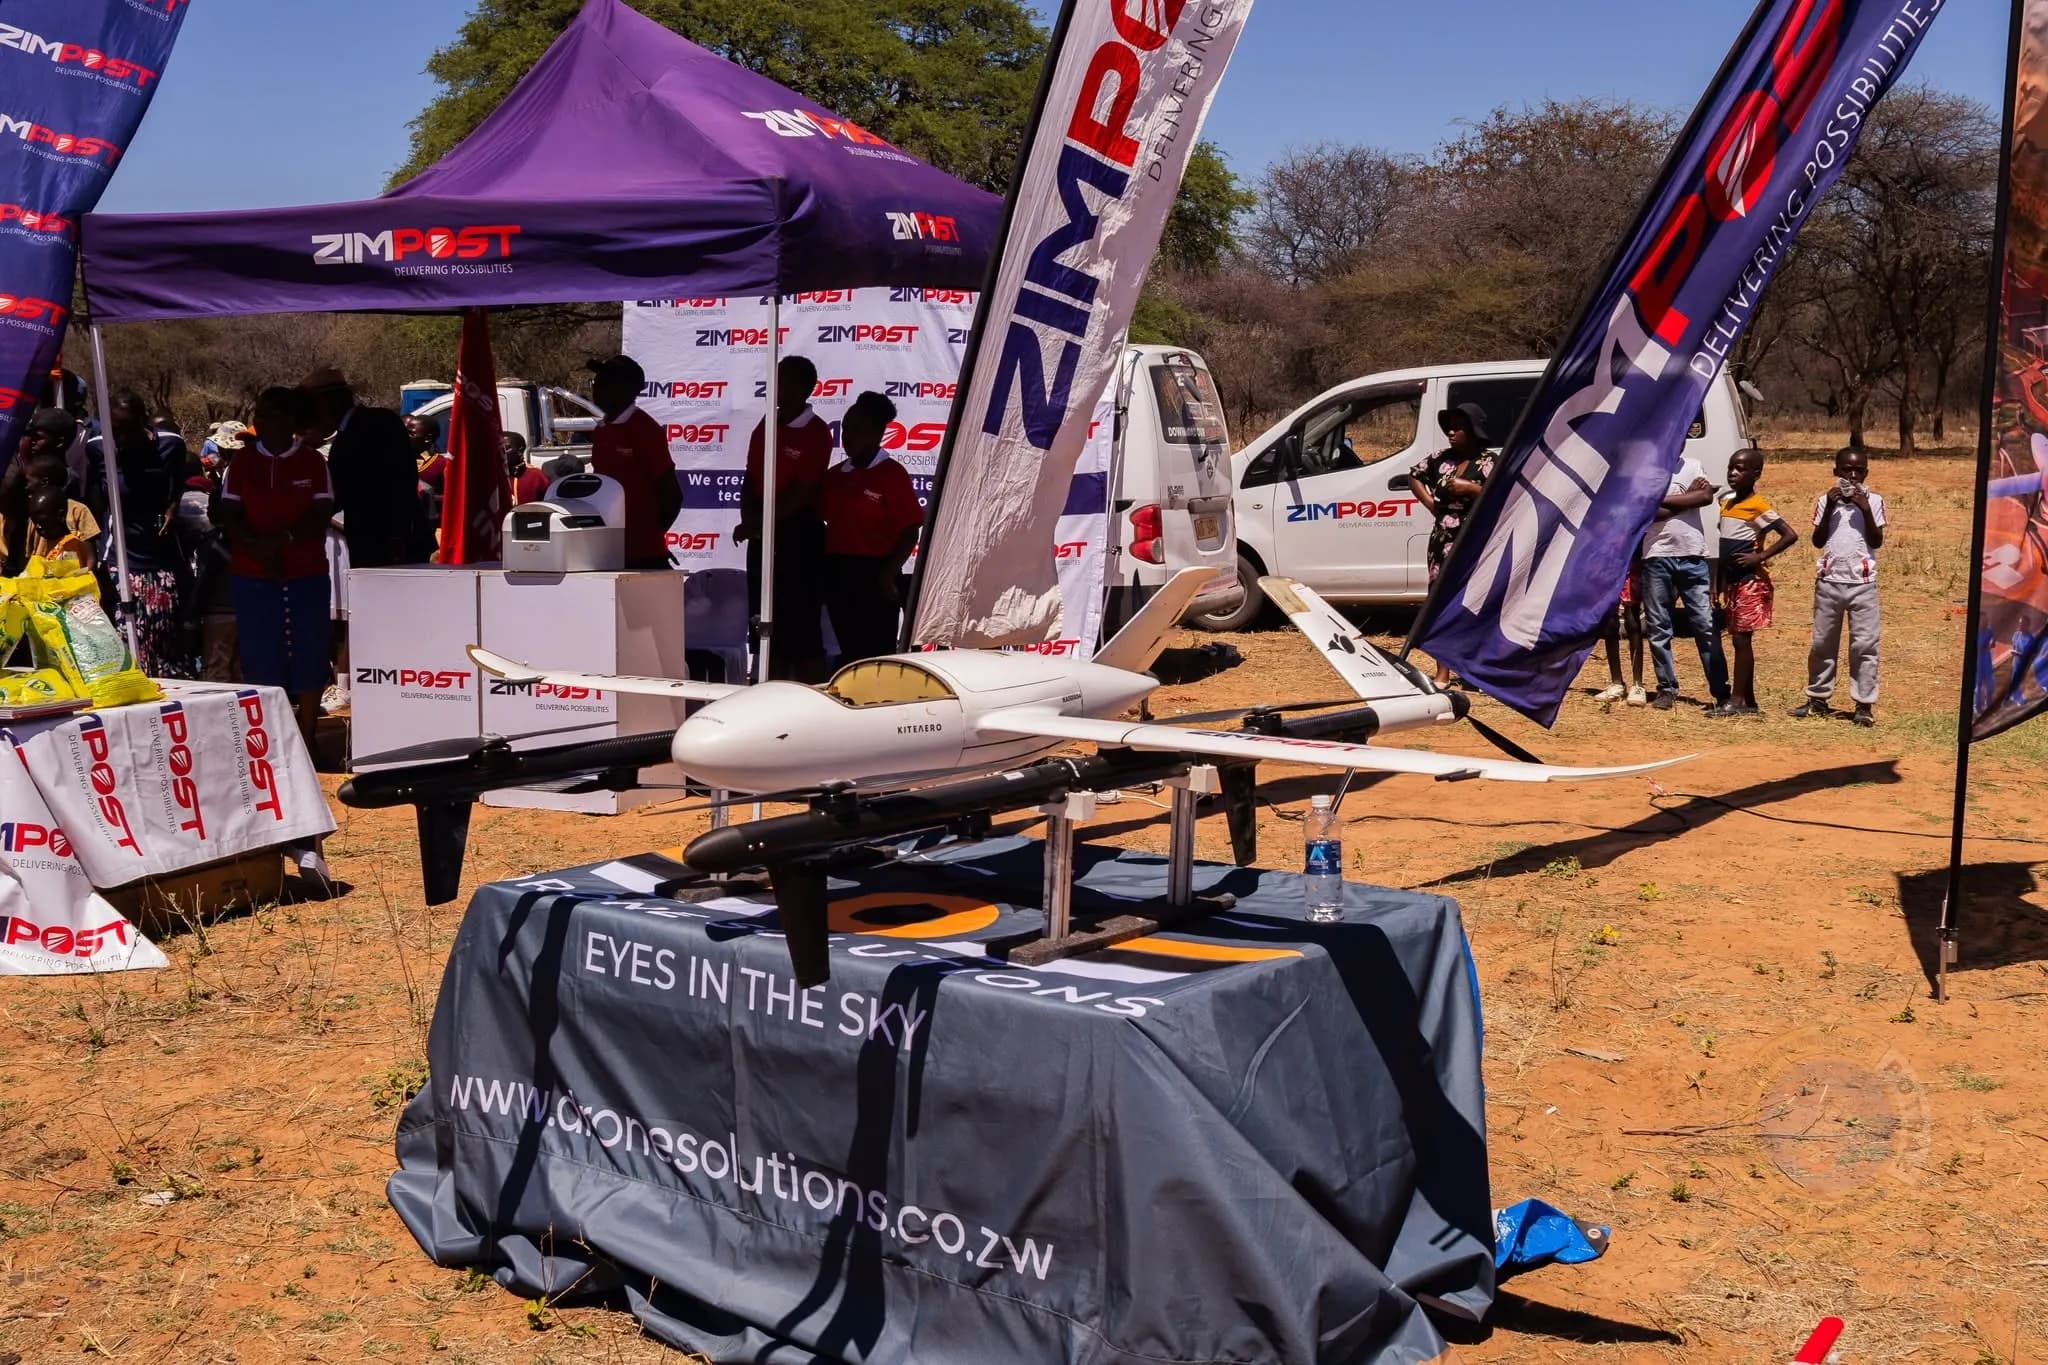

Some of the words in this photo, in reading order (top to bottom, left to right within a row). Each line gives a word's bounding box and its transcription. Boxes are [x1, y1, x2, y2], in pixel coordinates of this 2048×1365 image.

[0, 23, 157, 87] ZIMPOST
[55, 65, 94, 80] DELIVERING
[95, 74, 143, 96] POSSIBILITIES
[1148, 7, 1225, 182] DELIVERING
[311, 225, 521, 264] ZIMPOST
[394, 265, 449, 276] DELIVERING
[451, 263, 513, 275] POSSIBILITIES
[1690, 200, 1807, 380] DELIVERING
[818, 325, 919, 343] ZIMPOST
[663, 424, 729, 443] POST
[898, 455, 940, 466] POSSIBIL
[687, 473, 711, 486] We
[718, 490, 741, 501] tec
[1286, 498, 1419, 523] ZIMPOST
[356, 668, 472, 689] ZIMPOST
[401, 691, 433, 700] DELIVERING
[434, 692, 472, 702] POSSIBILITIES
[535, 703, 570, 712] DELIVERING
[570, 703, 609, 713] POSSIBILITIES
[897, 723, 942, 735] KITEAERO
[68, 734, 88, 791] DELIVERING
[226, 700, 243, 753] DELIVERING
[236, 754, 252, 815] POSSIBILITIES
[150, 717, 166, 772] DELIVERING
[159, 773, 177, 835] POSSIBILITIES
[12, 858, 66, 871] DELIVERING
[585, 930, 676, 992] EYES
[688, 949, 731, 1005] IN
[740, 965, 827, 1030] THE
[839, 988, 929, 1053] SKY
[450, 1072, 1055, 1282] www.dronesolutions.co.zw
